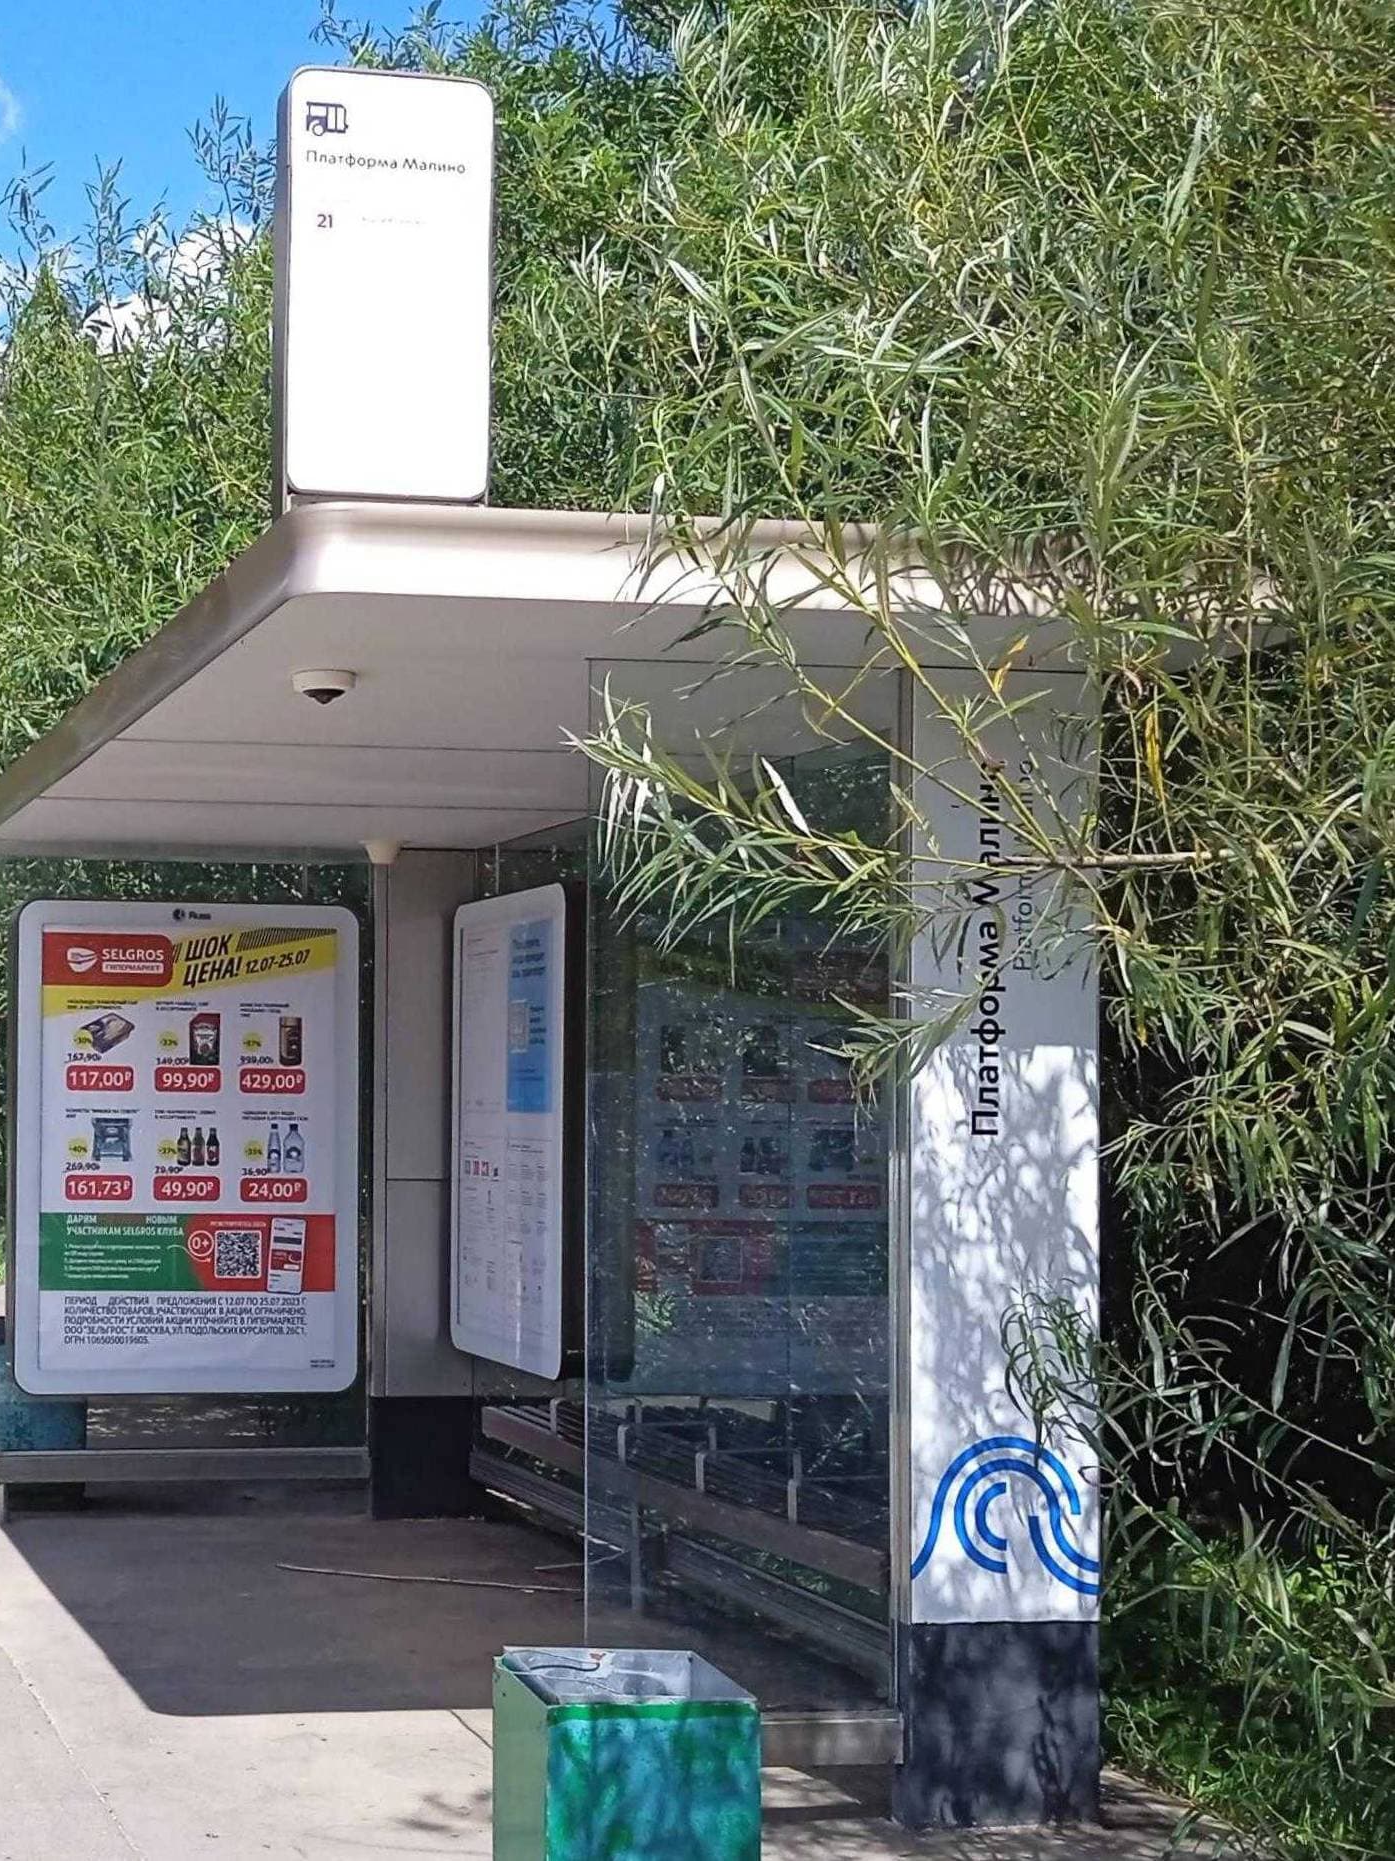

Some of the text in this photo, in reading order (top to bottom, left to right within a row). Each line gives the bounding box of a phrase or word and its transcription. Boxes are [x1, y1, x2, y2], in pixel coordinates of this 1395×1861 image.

[306, 150, 466, 175] Платформа Малино
[317, 213, 333, 229] 21
[1012, 855, 1034, 971] Platform
[102, 948, 164, 961] SELGROS
[185, 934, 233, 962] ШОК
[182, 949, 311, 988] ЦЕНА! 12.07-25.07
[970, 922, 1006, 1136] Платформа
[192, 1237, 210, 1250] 0+
